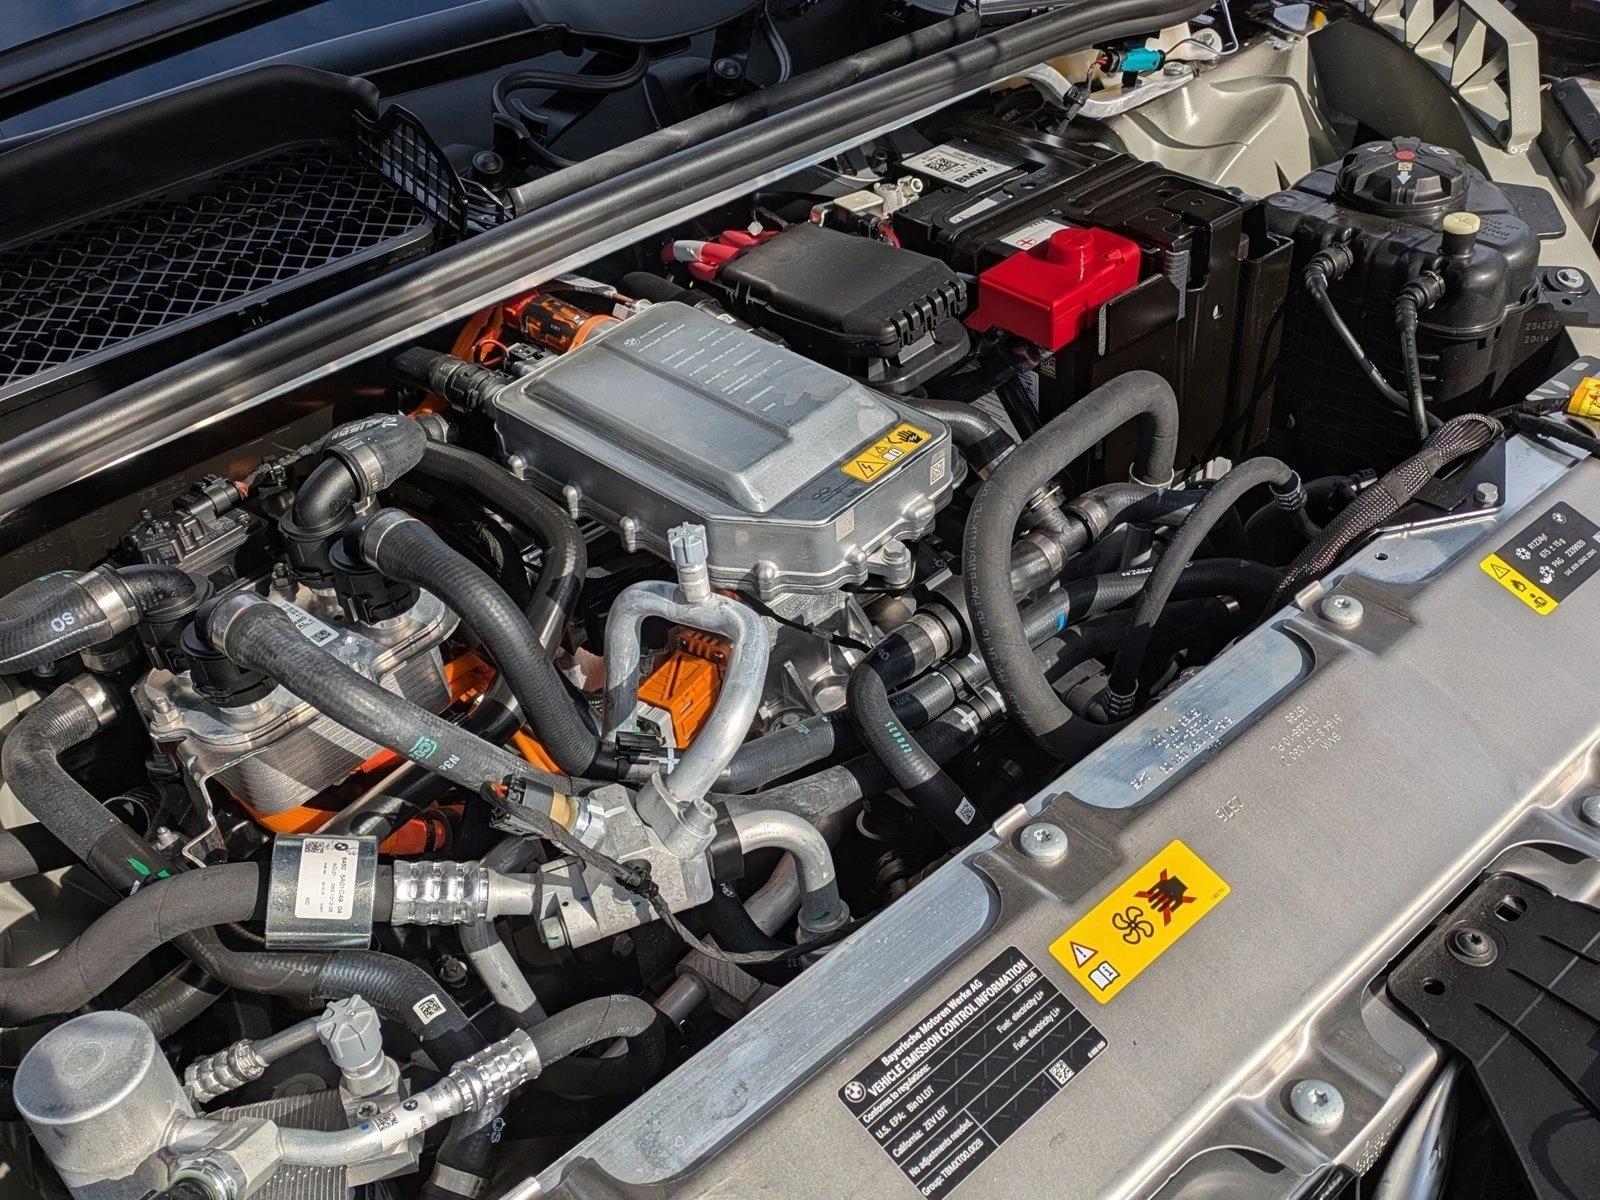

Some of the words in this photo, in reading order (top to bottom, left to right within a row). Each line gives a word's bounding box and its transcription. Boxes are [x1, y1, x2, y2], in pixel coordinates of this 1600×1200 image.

[954, 166, 989, 184] BMW
[1526, 531, 1549, 551] R1234yf
[1538, 546, 1552, 559] 675
[1550, 555, 1565, 569] PAG
[1269, 740, 1285, 756] PL
[1317, 729, 1341, 752] BMW
[336, 905, 343, 914] 04
[1011, 981, 1025, 995] MY
[1020, 969, 1038, 988] 2026
[880, 1028, 923, 1068] Bayerische
[918, 1003, 952, 1035] Motoren
[947, 986, 973, 1012] Werke
[968, 977, 983, 993] AG
[995, 1016, 1013, 1035] Fuel:
[1009, 995, 1039, 1023] electricity
[1033, 988, 1046, 1002] Li+
[867, 1062, 906, 1098] VEHICLE
[899, 1030, 944, 1070] EMISSION
[938, 1000, 979, 1038] CONTROL
[973, 957, 1029, 1008] INFORMATION
[1011, 1033, 1030, 1052] Fuel:
[1025, 1011, 1055, 1039] electricity
[1049, 1004, 1063, 1019] Li+
[861, 1094, 893, 1124] Conforms
[888, 1089, 899, 1101] to
[895, 1061, 932, 1097] regulations:
[874, 1122, 892, 1140] U.S.
[888, 1109, 907, 1128] EPA:
[905, 1098, 920, 1113] Bin
[919, 1084, 935, 1101] LDT
[891, 1127, 924, 1159] California:
[921, 1115, 938, 1132] ZEV
[933, 1105, 949, 1122] LDT
[907, 1163, 921, 1178] No
[916, 1134, 954, 1171] adjustments
[948, 1115, 974, 1143] needed.
[920, 1172, 945, 1198] Group:
